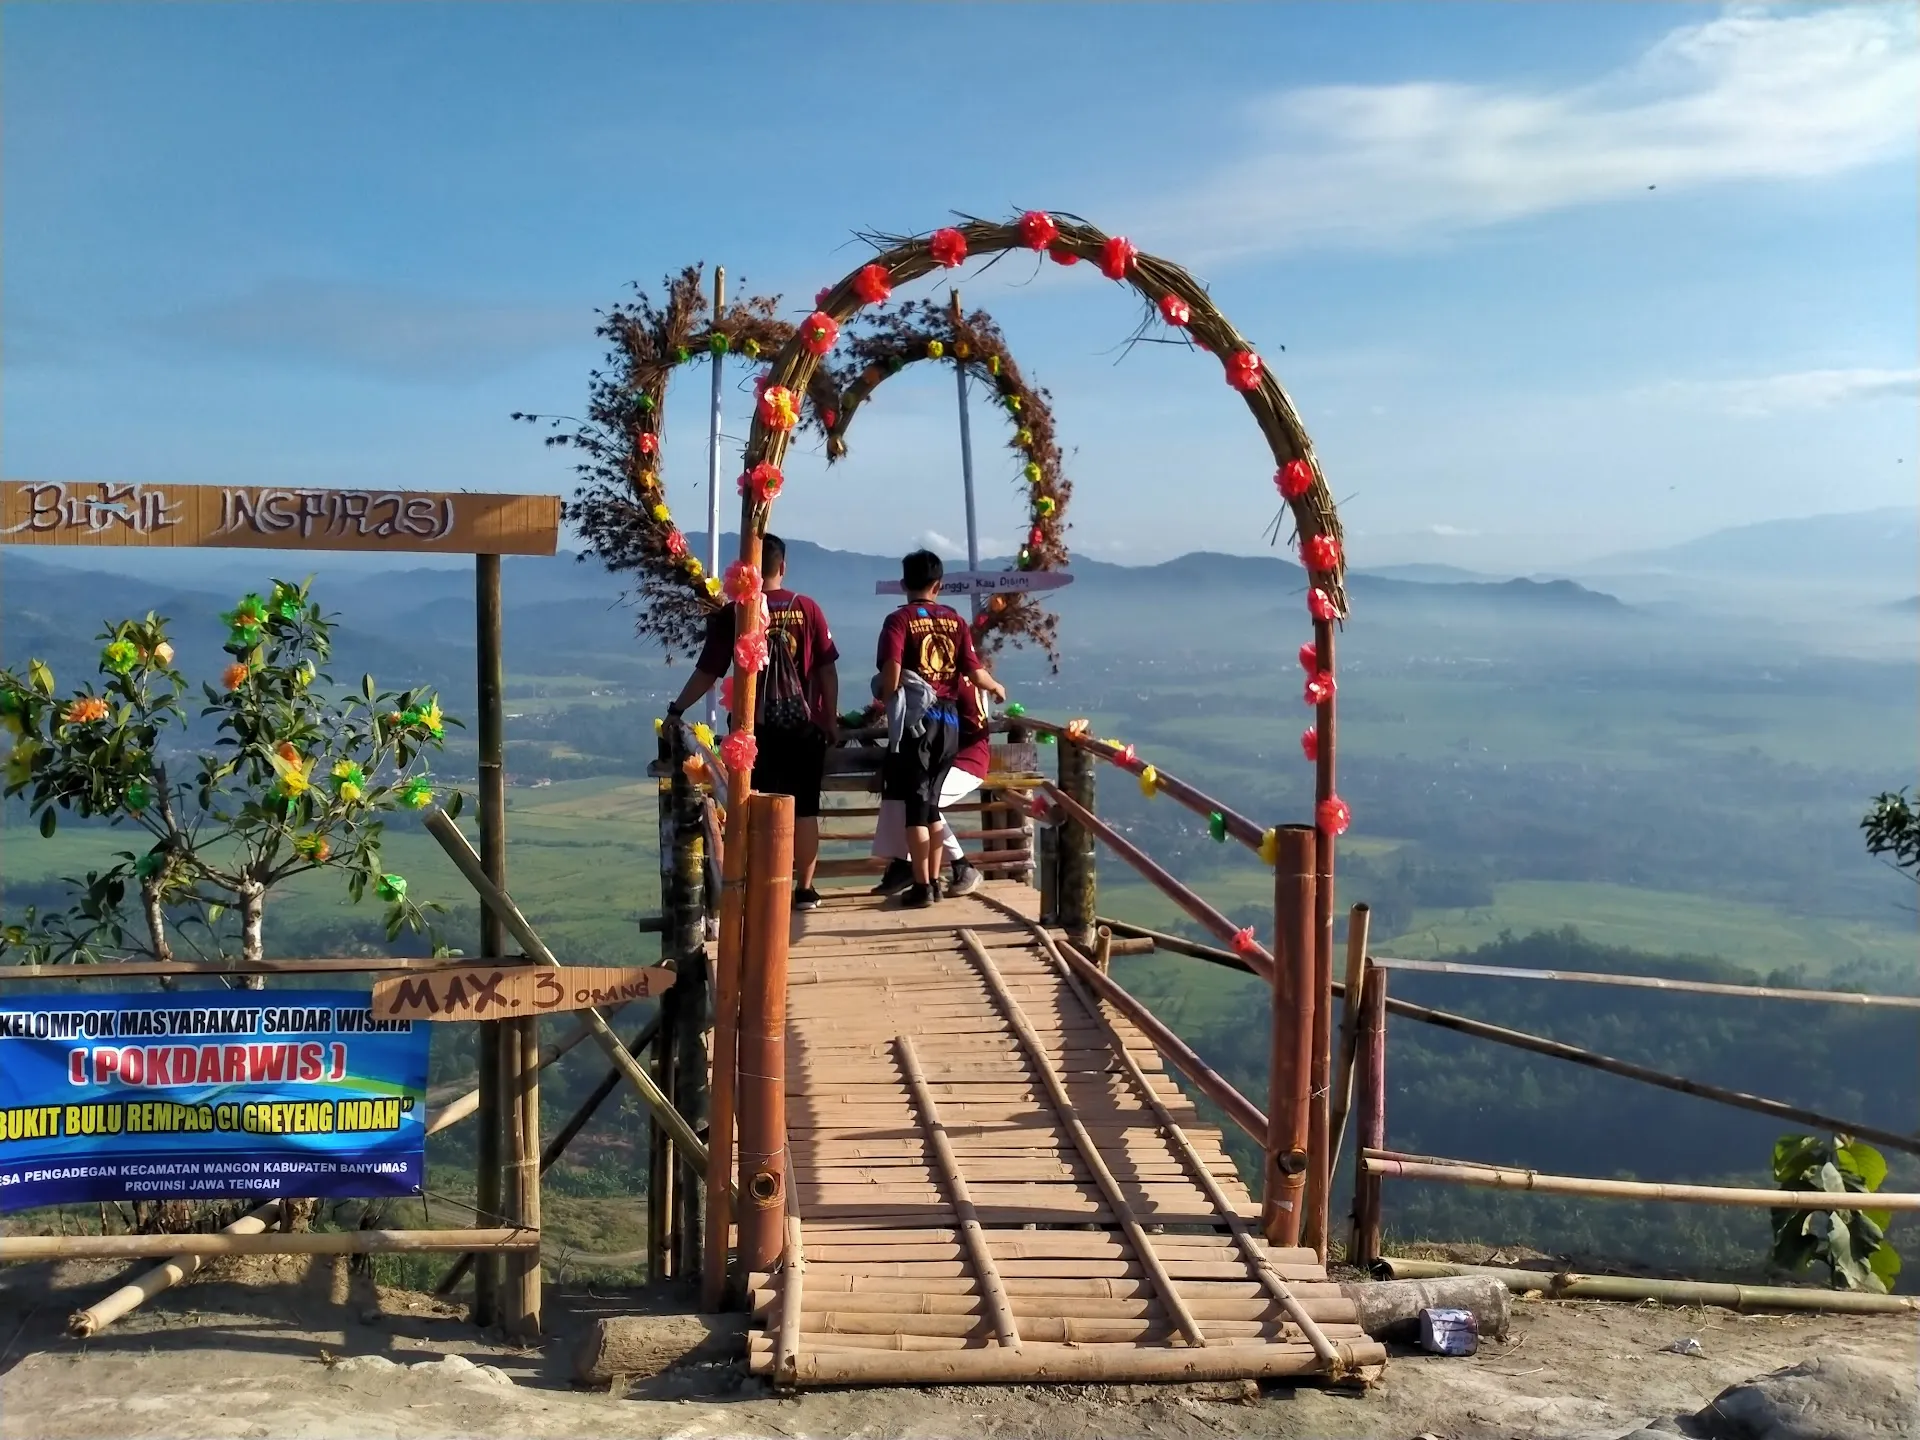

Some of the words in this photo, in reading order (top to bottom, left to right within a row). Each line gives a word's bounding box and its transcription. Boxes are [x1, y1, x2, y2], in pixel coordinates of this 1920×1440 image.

[532, 972, 565, 1008] 3
[0, 1011, 116, 1040] KELOMPOK
[118, 1008, 260, 1037] MASYARAKAT
[264, 1008, 332, 1034] SADAR
[94, 1043, 324, 1086] POKDARWIS
[65, 1103, 122, 1136] BULU
[126, 1102, 213, 1133] REMPAG
[217, 1104, 239, 1131] CI
[243, 1101, 334, 1134] GREYENG
[24, 1166, 117, 1183] PENGADEGAN
[120, 1163, 201, 1176] KECAMATAN
[203, 1162, 260, 1174] WANGON
[263, 1162, 337, 1173] KABUPATEN
[340, 1162, 408, 1174] BANYUMAS
[124, 1180, 186, 1192] PROVINSI
[189, 1179, 225, 1191] JAWA
[229, 1178, 281, 1190] TENGAH
